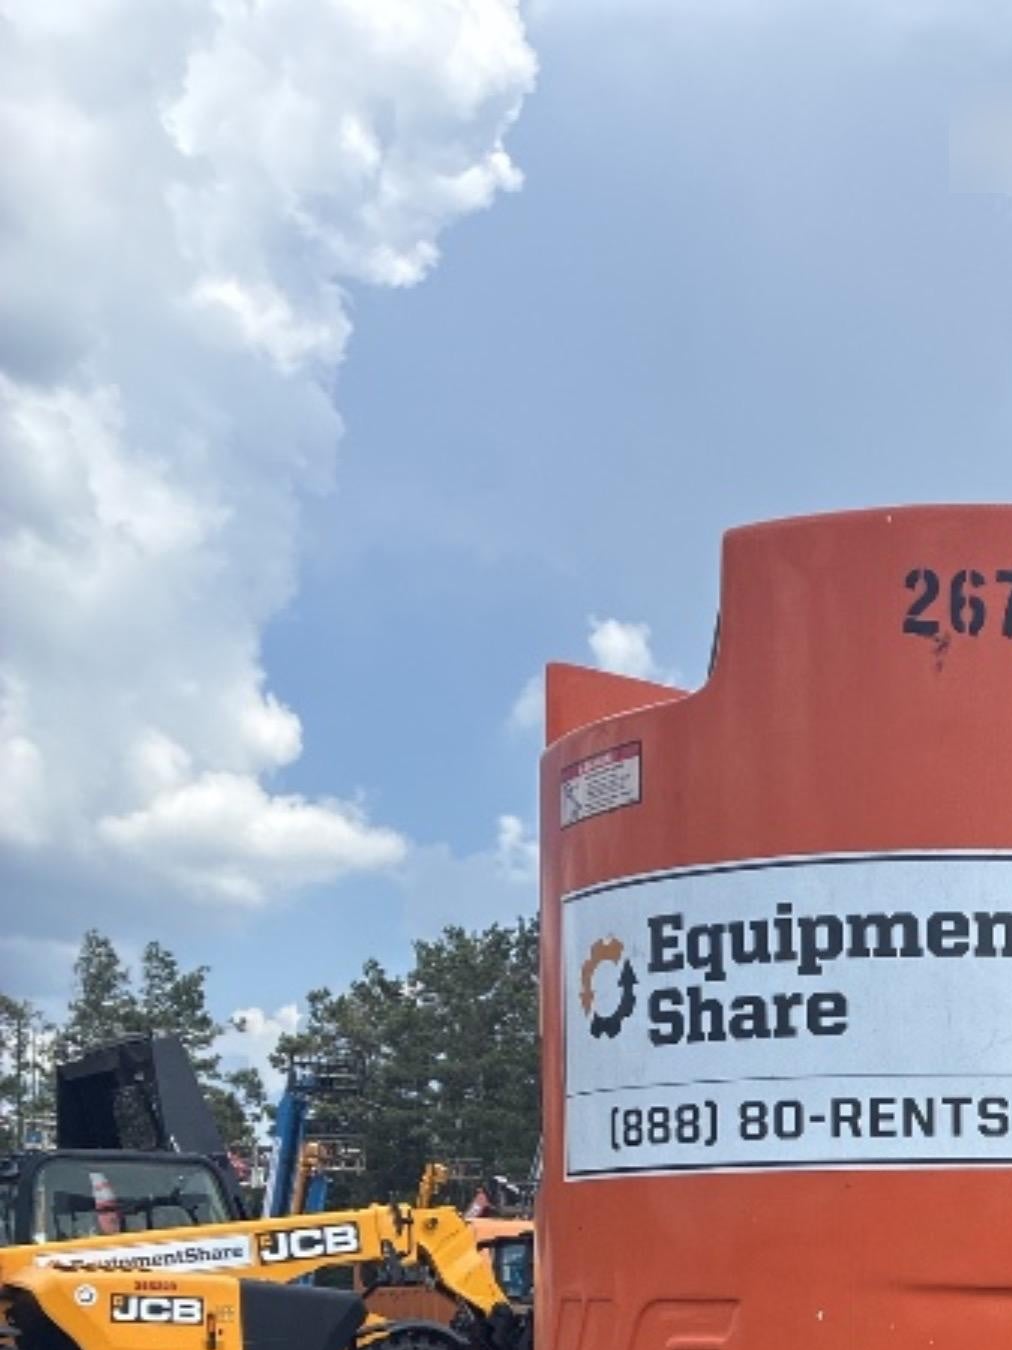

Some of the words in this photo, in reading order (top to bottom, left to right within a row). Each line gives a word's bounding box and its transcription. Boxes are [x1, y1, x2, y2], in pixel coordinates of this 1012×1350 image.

[647, 985, 849, 1047] Share
[610, 1100, 719, 1151] (888)
[739, 1096, 1010, 1141] 80-RENTS
[261, 1223, 359, 1262] JCB
[112, 1295, 202, 1323] JCB
